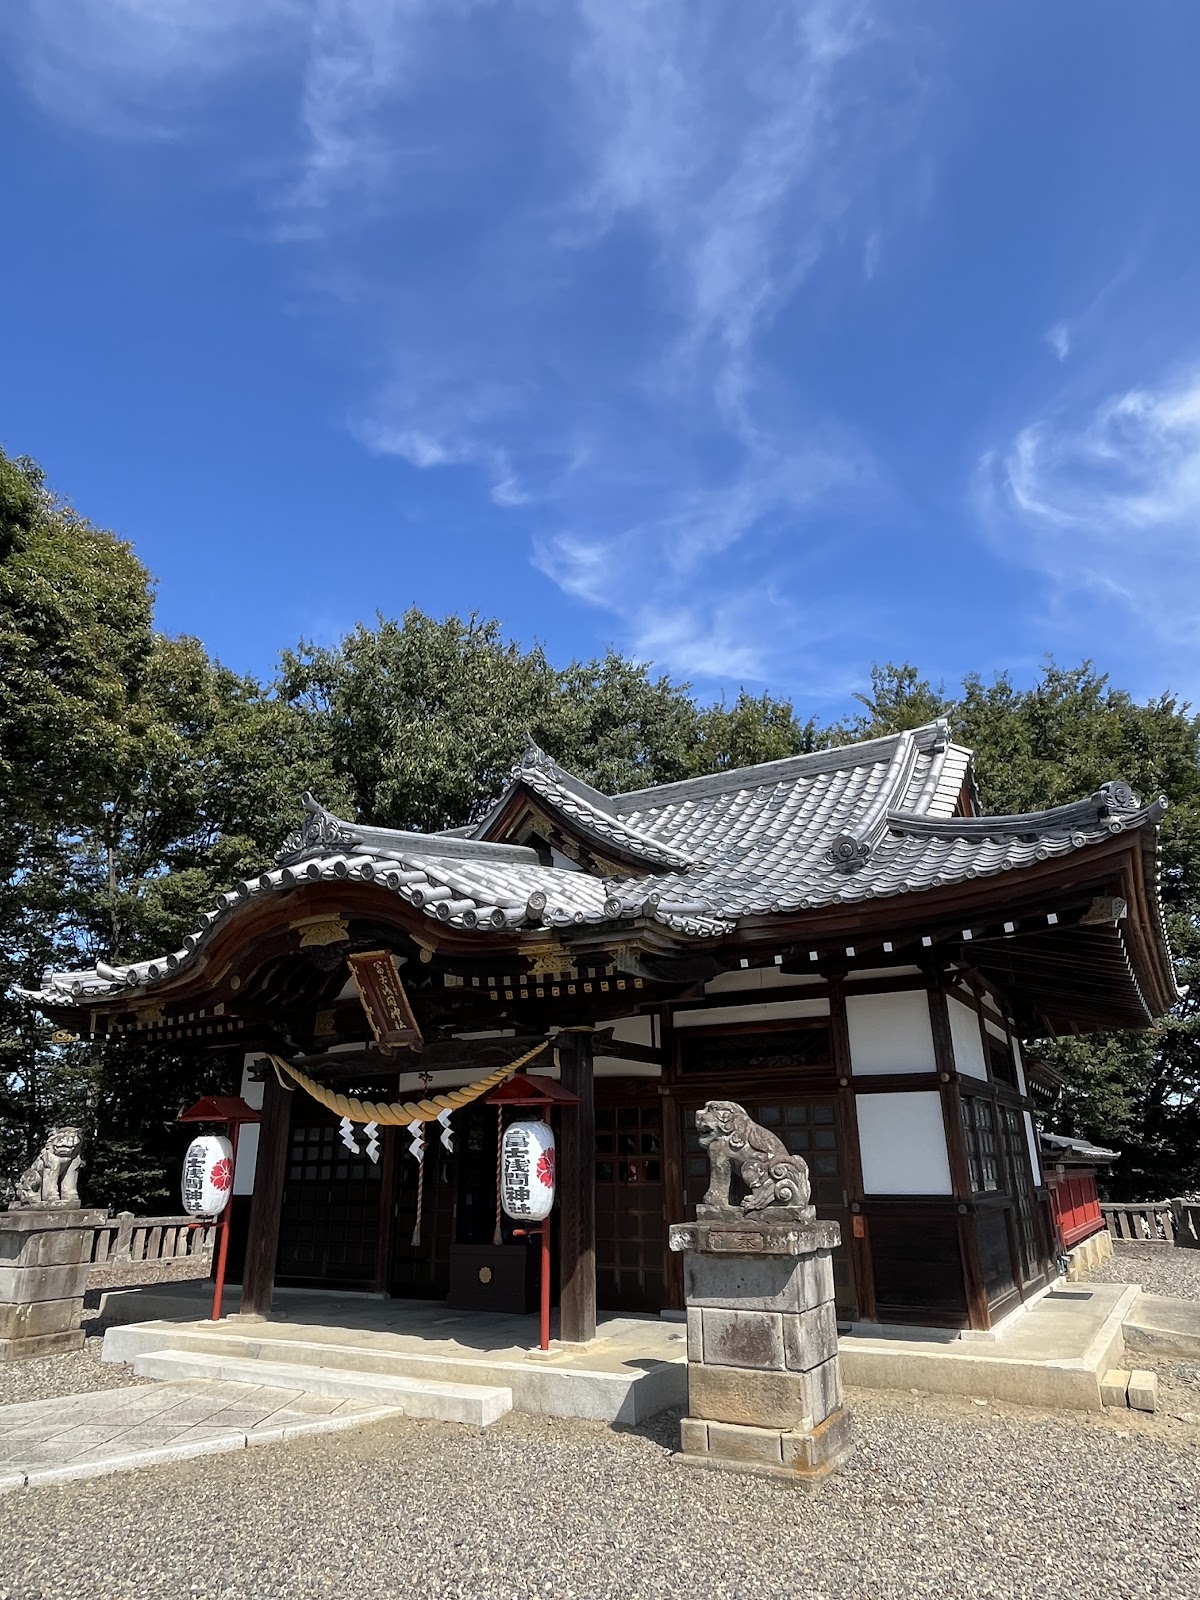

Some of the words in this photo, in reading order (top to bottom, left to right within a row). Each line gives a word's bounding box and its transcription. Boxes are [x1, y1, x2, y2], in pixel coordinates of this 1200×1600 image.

[185, 1144, 209, 1212] 富士浅間神社
[504, 1130, 531, 1214] 富士浅間神社
